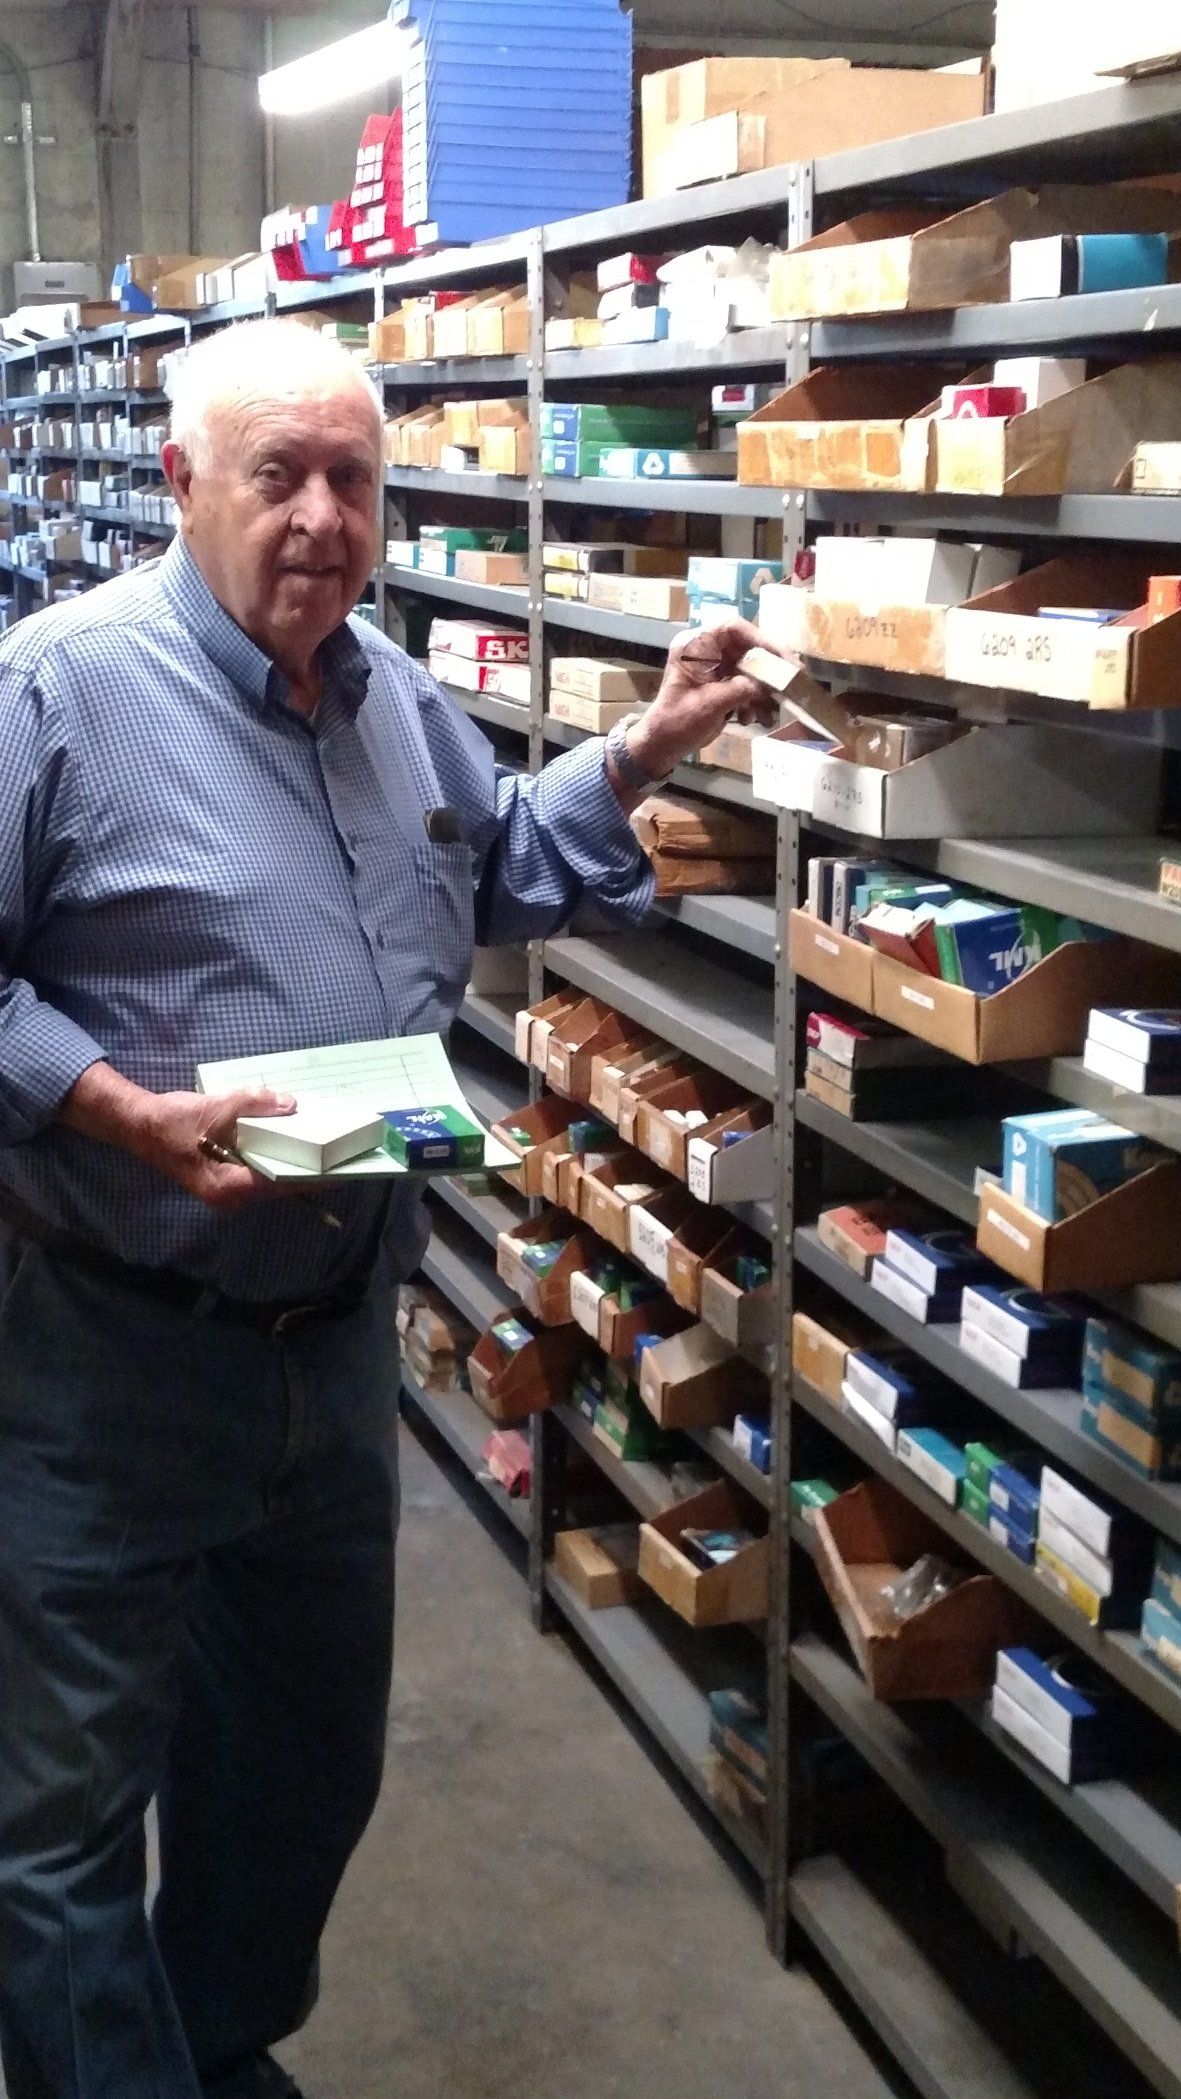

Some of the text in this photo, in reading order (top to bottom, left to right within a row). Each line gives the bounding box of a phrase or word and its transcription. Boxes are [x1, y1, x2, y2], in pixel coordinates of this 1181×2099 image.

[484, 640, 529, 660] SK
[981, 632, 1051, 662] 6209 2RS
[988, 930, 1042, 980] KML
